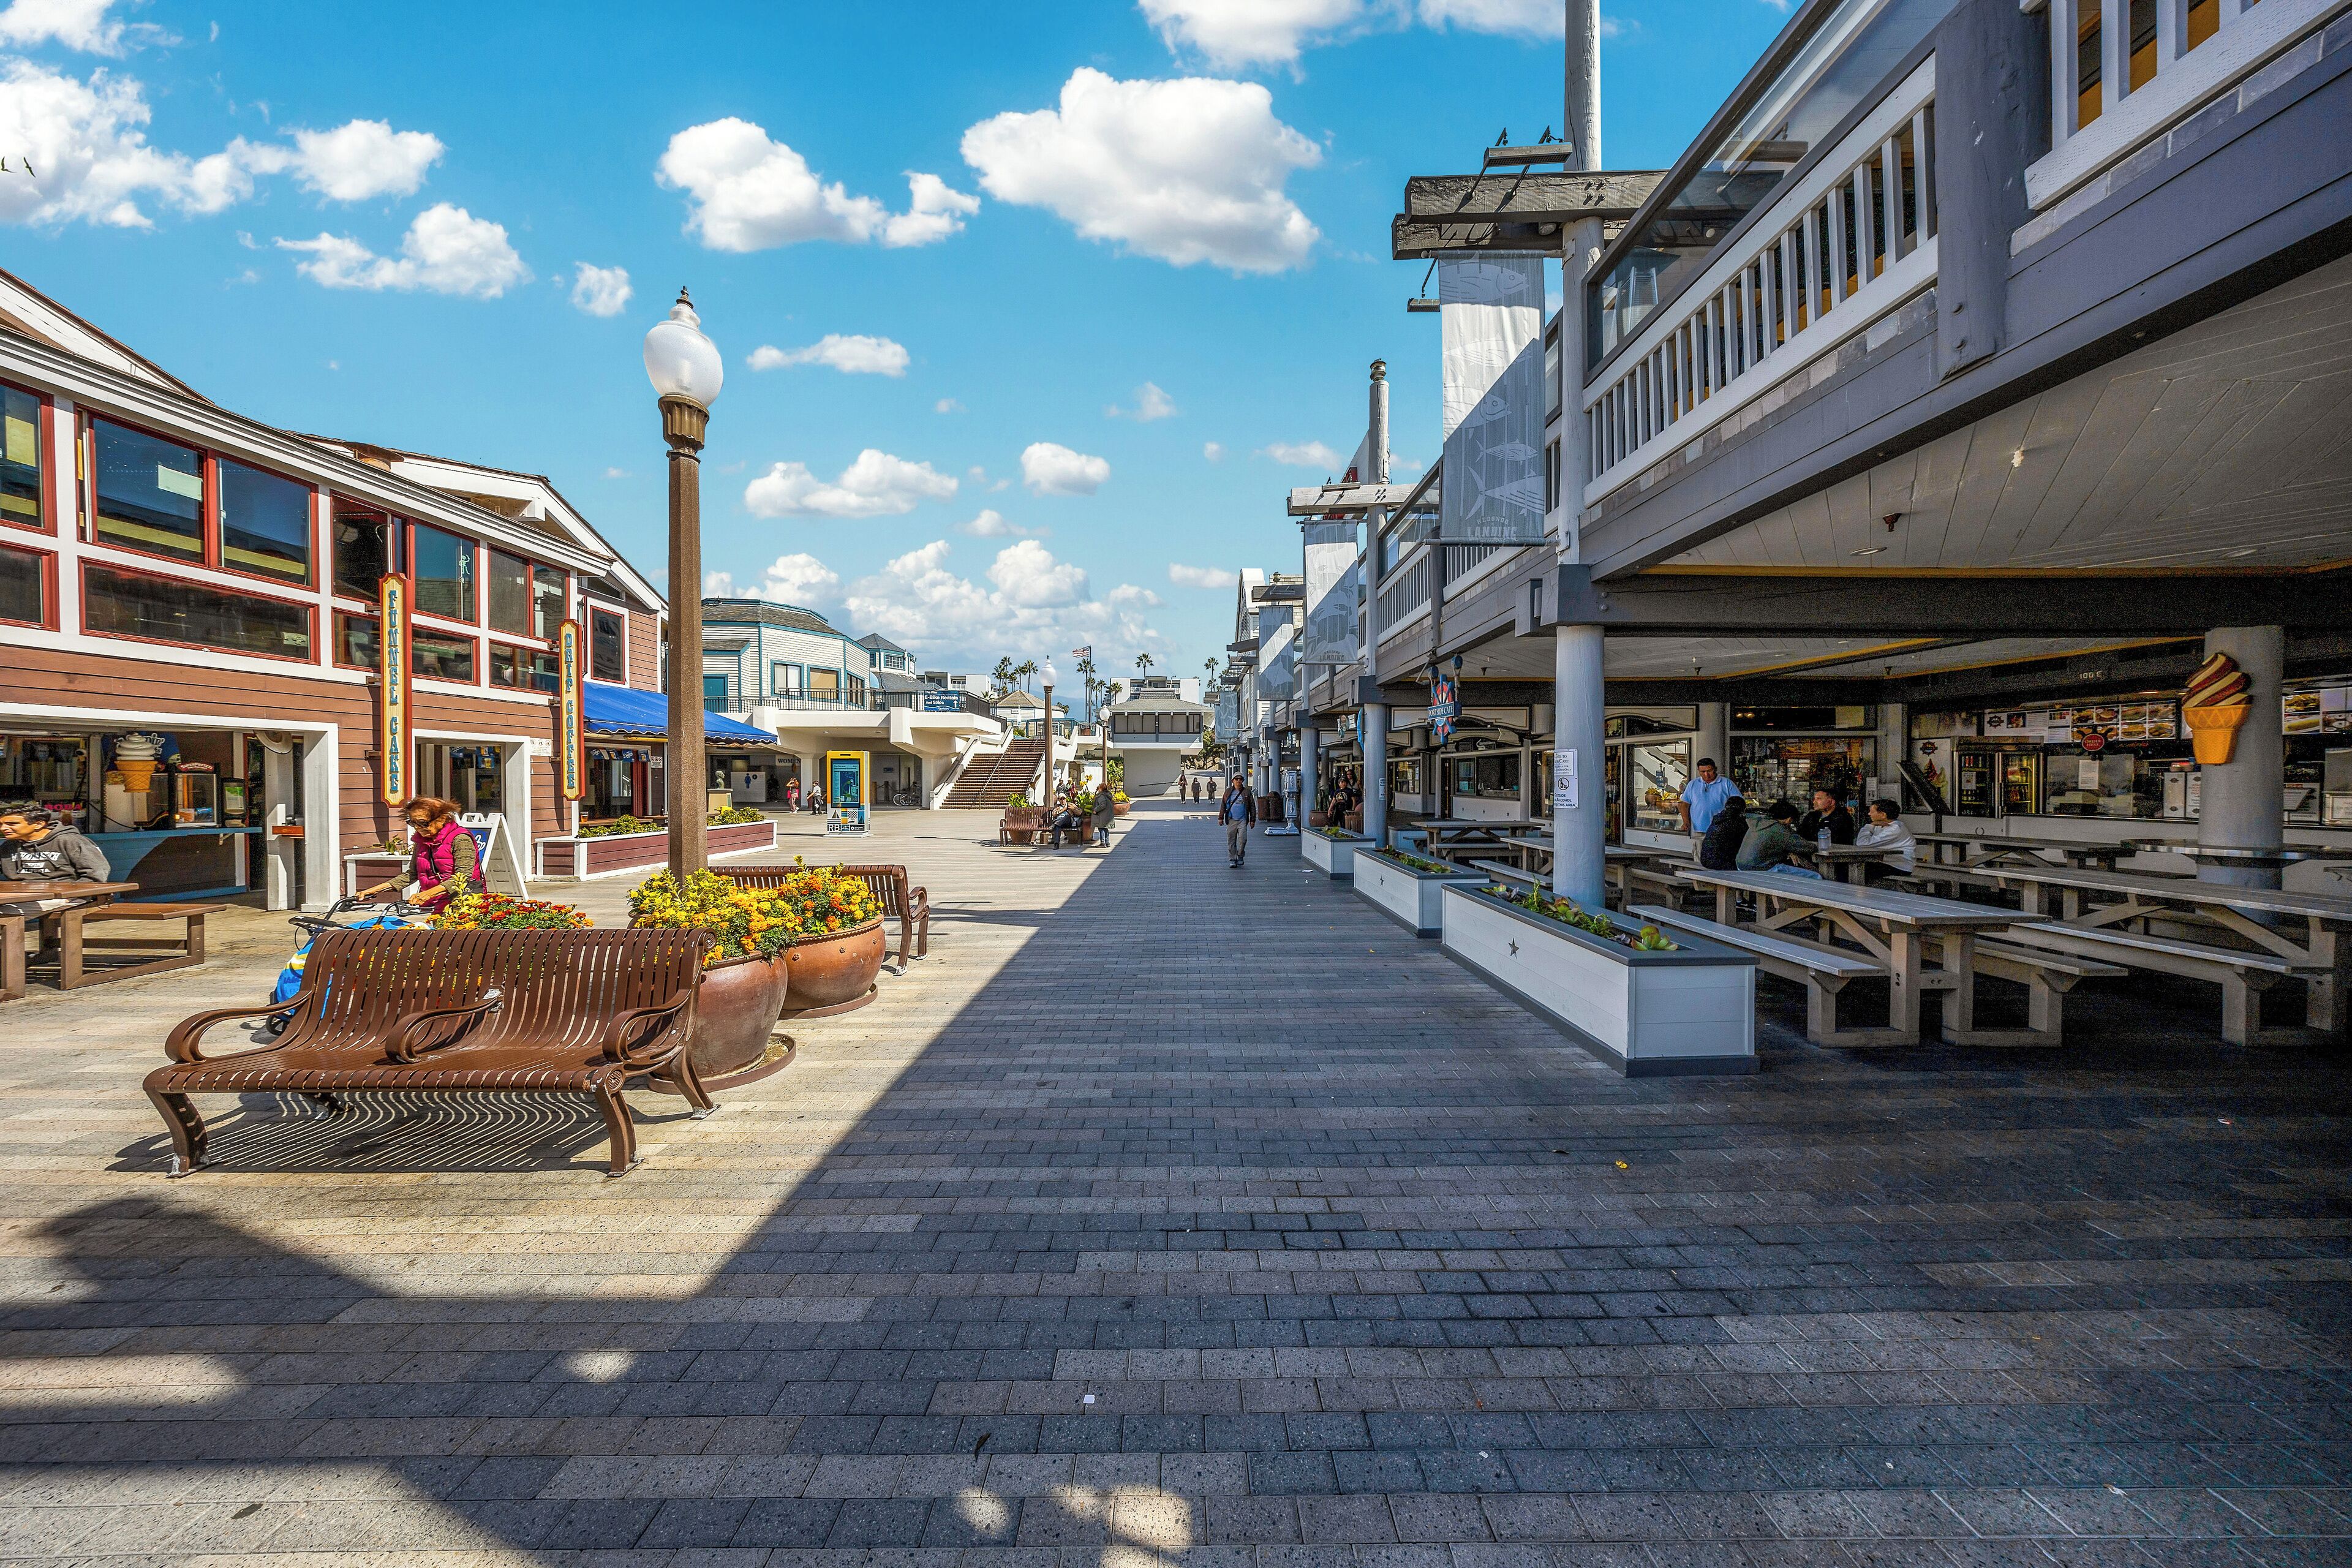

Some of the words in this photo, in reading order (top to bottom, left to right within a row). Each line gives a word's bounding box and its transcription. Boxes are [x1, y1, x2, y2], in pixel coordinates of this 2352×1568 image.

[1477, 516, 1509, 524] REDONDO
[388, 590, 399, 705] FUNNEL
[565, 633, 573, 693] DRIP
[566, 699, 575, 789] COFFEE
[1428, 707, 1444, 717] PORTSIDE
[1444, 705, 1453, 714] CAFE
[389, 716, 399, 793] CAKE
